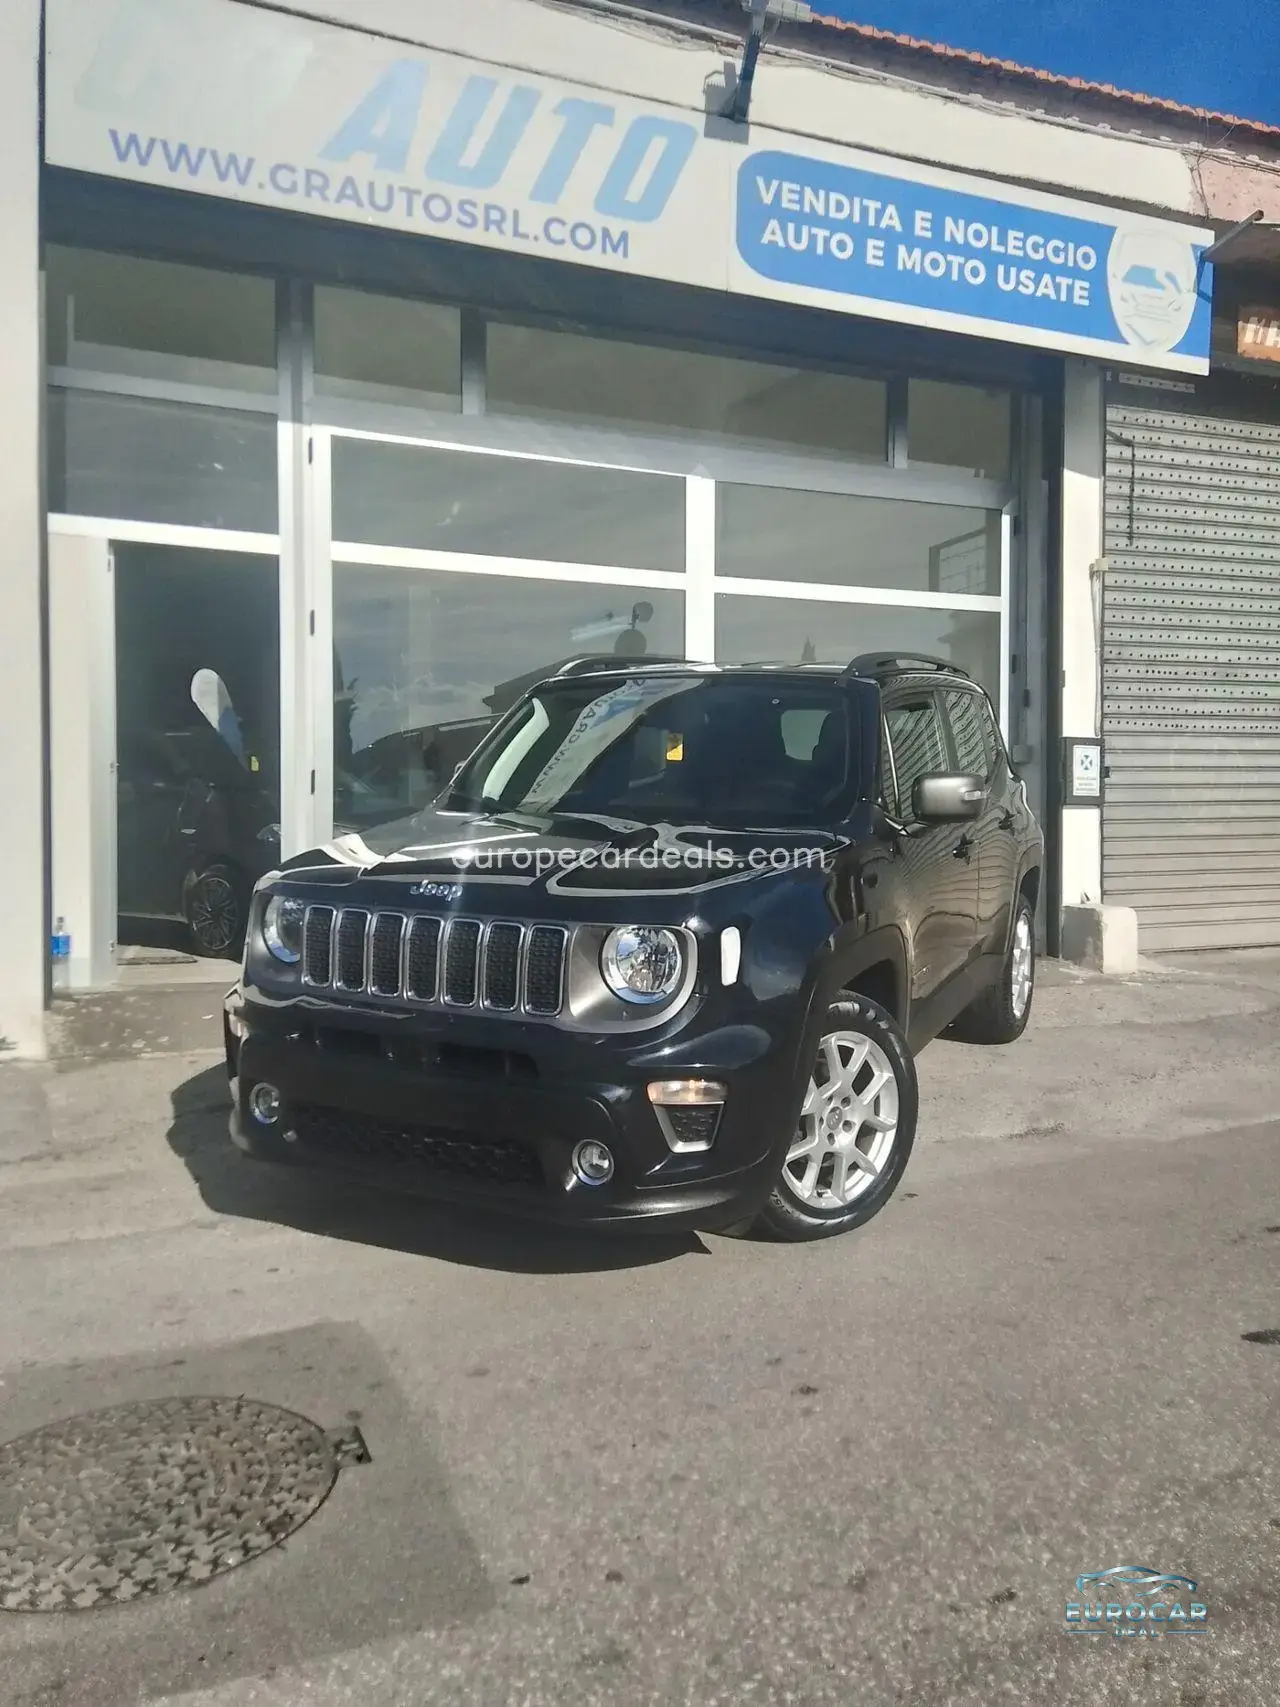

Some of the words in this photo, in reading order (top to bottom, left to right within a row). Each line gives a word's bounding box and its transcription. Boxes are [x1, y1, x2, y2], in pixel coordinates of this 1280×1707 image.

[317, 57, 699, 224] AUTO
[107, 127, 630, 260] WWW.GRAUTOSRL.COM
[755, 175, 903, 233] VENDITA
[914, 209, 933, 240] E
[944, 215, 1097, 272] NOLEGGIO
[760, 217, 855, 261] AUTO
[866, 237, 886, 268] E
[897, 242, 987, 286] MOTO
[996, 263, 1091, 307] USATE
[408, 879, 464, 902] Jeep
